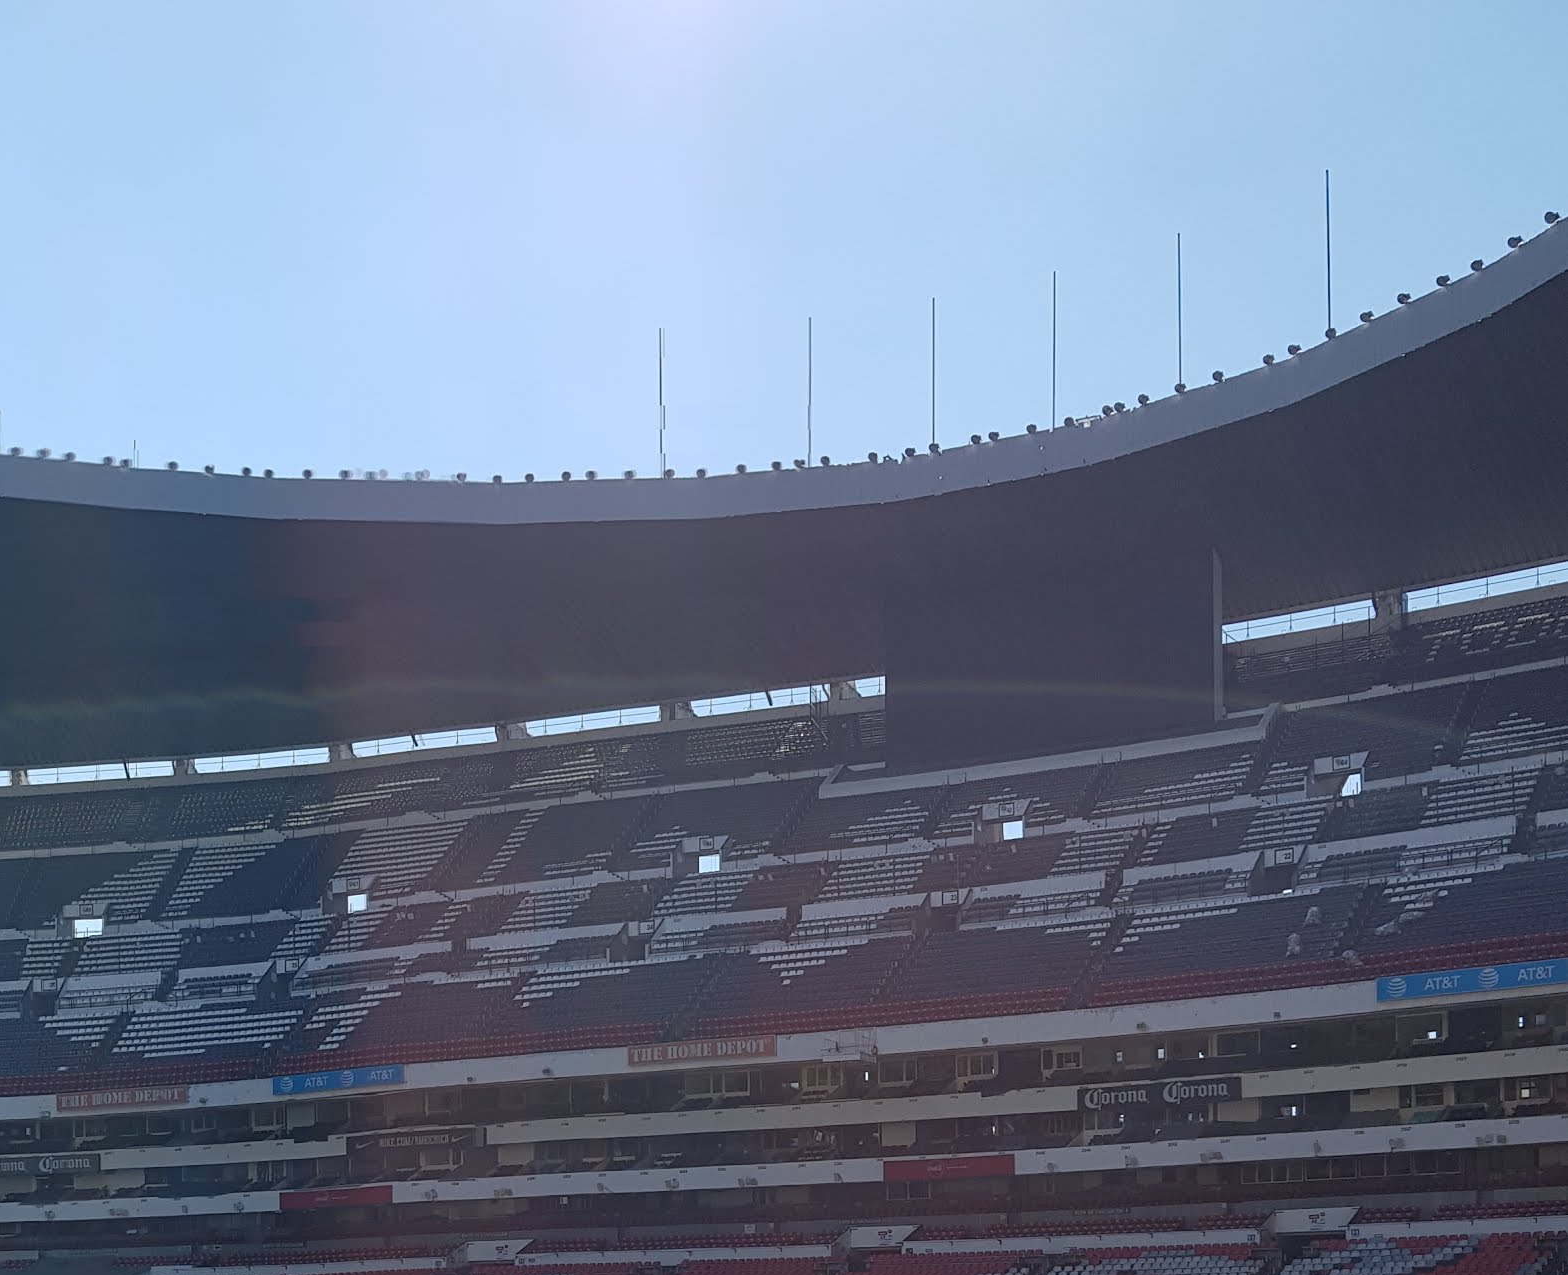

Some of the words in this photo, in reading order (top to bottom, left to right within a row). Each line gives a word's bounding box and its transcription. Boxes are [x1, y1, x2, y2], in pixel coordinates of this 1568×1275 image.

[1517, 965, 1556, 982] AT&T
[1424, 975, 1461, 991] AT&T
[629, 1048, 664, 1062] THE
[666, 1042, 712, 1060] HOME
[715, 1038, 769, 1056] DEPOT
[303, 1075, 329, 1087] AT&T
[369, 1068, 395, 1081] AT&T
[1084, 1088, 1149, 1110] Corona
[1162, 1081, 1230, 1104] Corona
